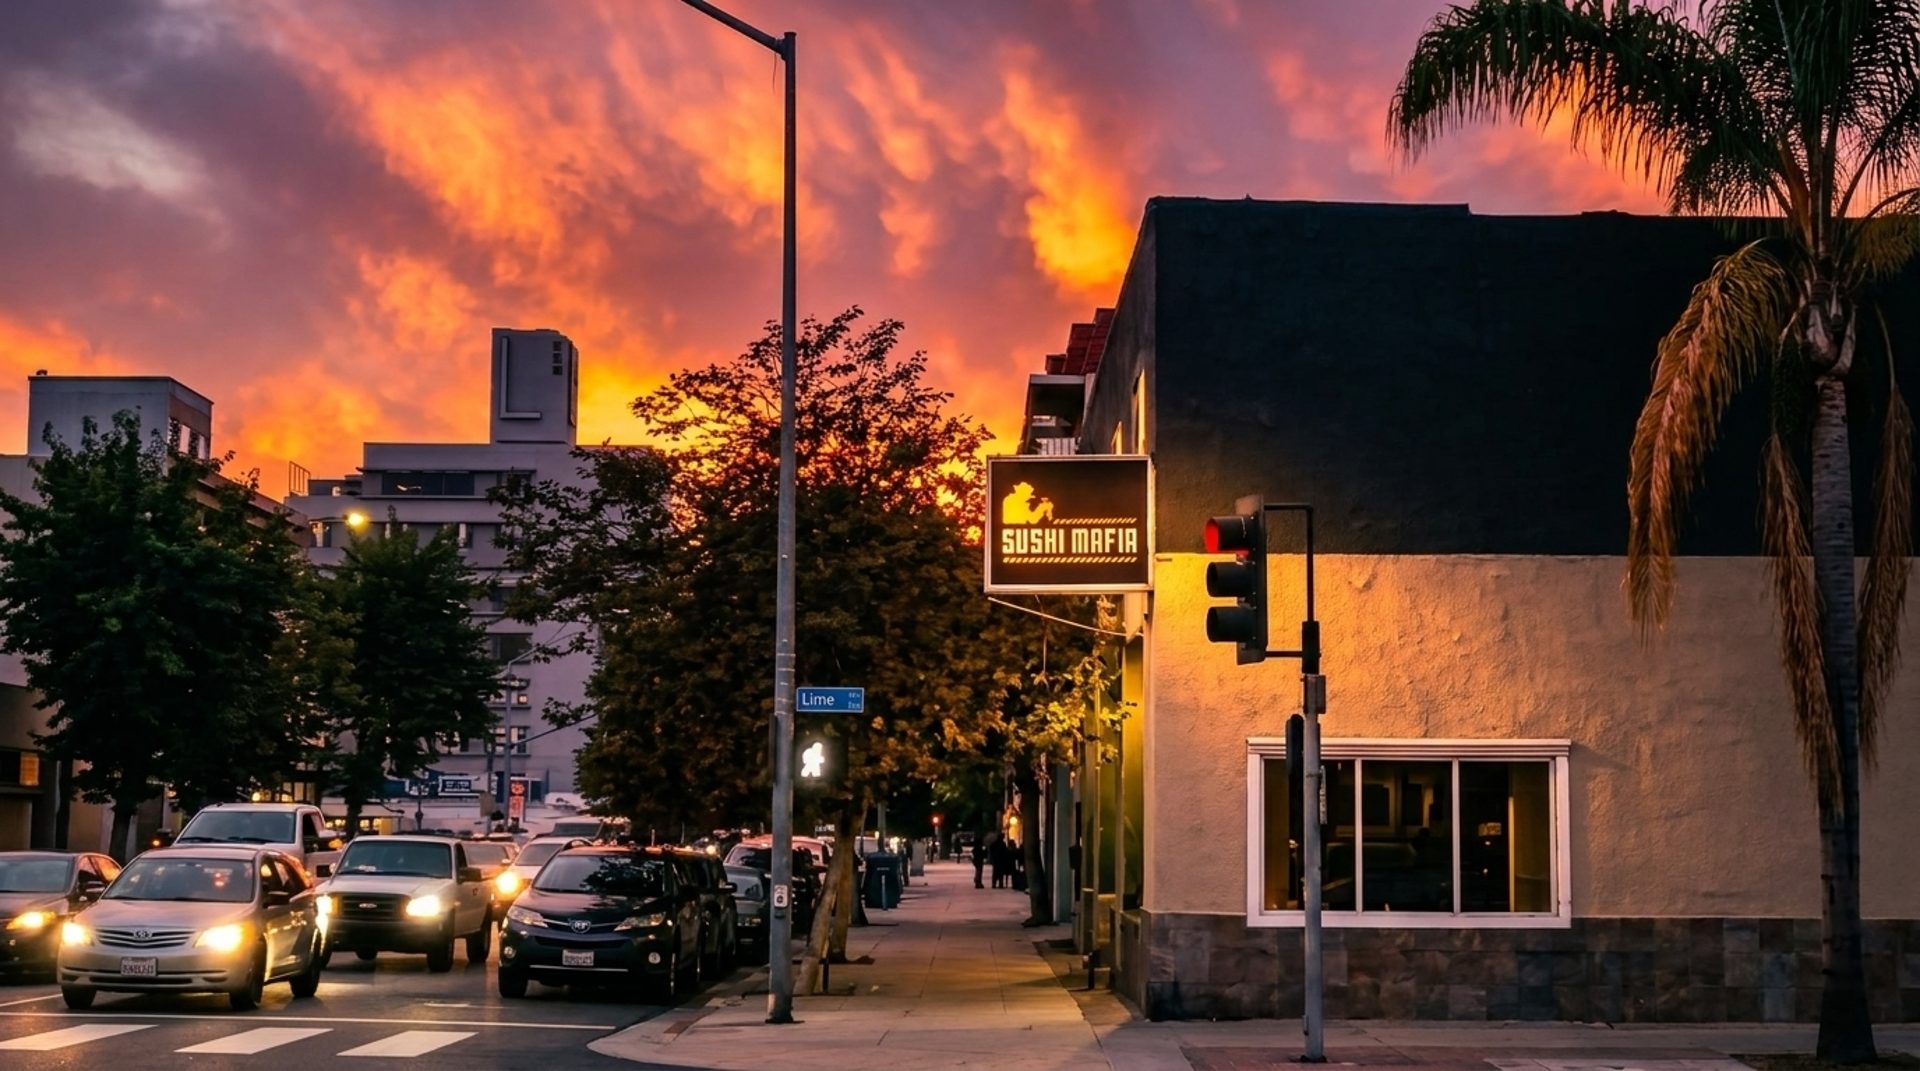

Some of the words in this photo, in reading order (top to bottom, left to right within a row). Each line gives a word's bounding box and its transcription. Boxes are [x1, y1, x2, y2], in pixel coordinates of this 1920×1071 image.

[1002, 528, 1065, 554] SUSHI
[1071, 528, 1138, 554] MAFIA
[802, 692, 835, 706] Lime
